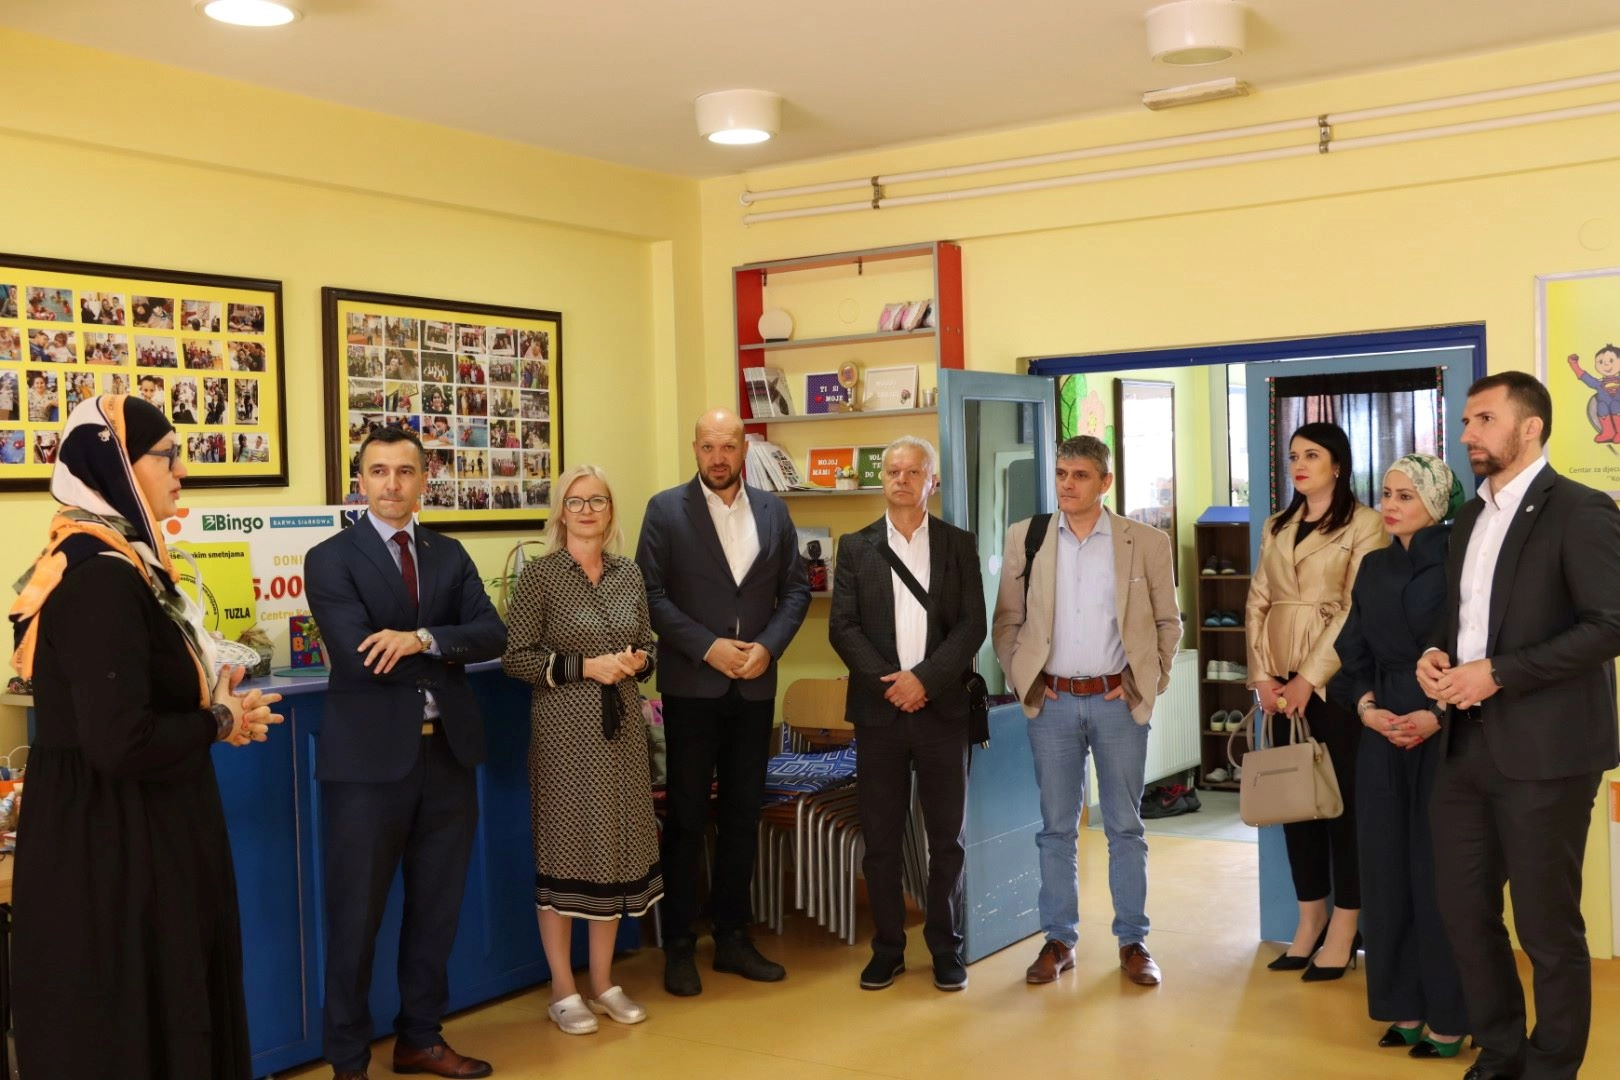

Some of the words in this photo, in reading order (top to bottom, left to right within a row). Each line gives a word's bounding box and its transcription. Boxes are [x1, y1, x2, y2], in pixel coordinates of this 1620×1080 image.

[216, 514, 264, 534] Bingo
[208, 551, 245, 560] smetnjama
[273, 555, 304, 567] DONI
[252, 575, 303, 602] 5.00
[224, 607, 251, 620] TUZLA
